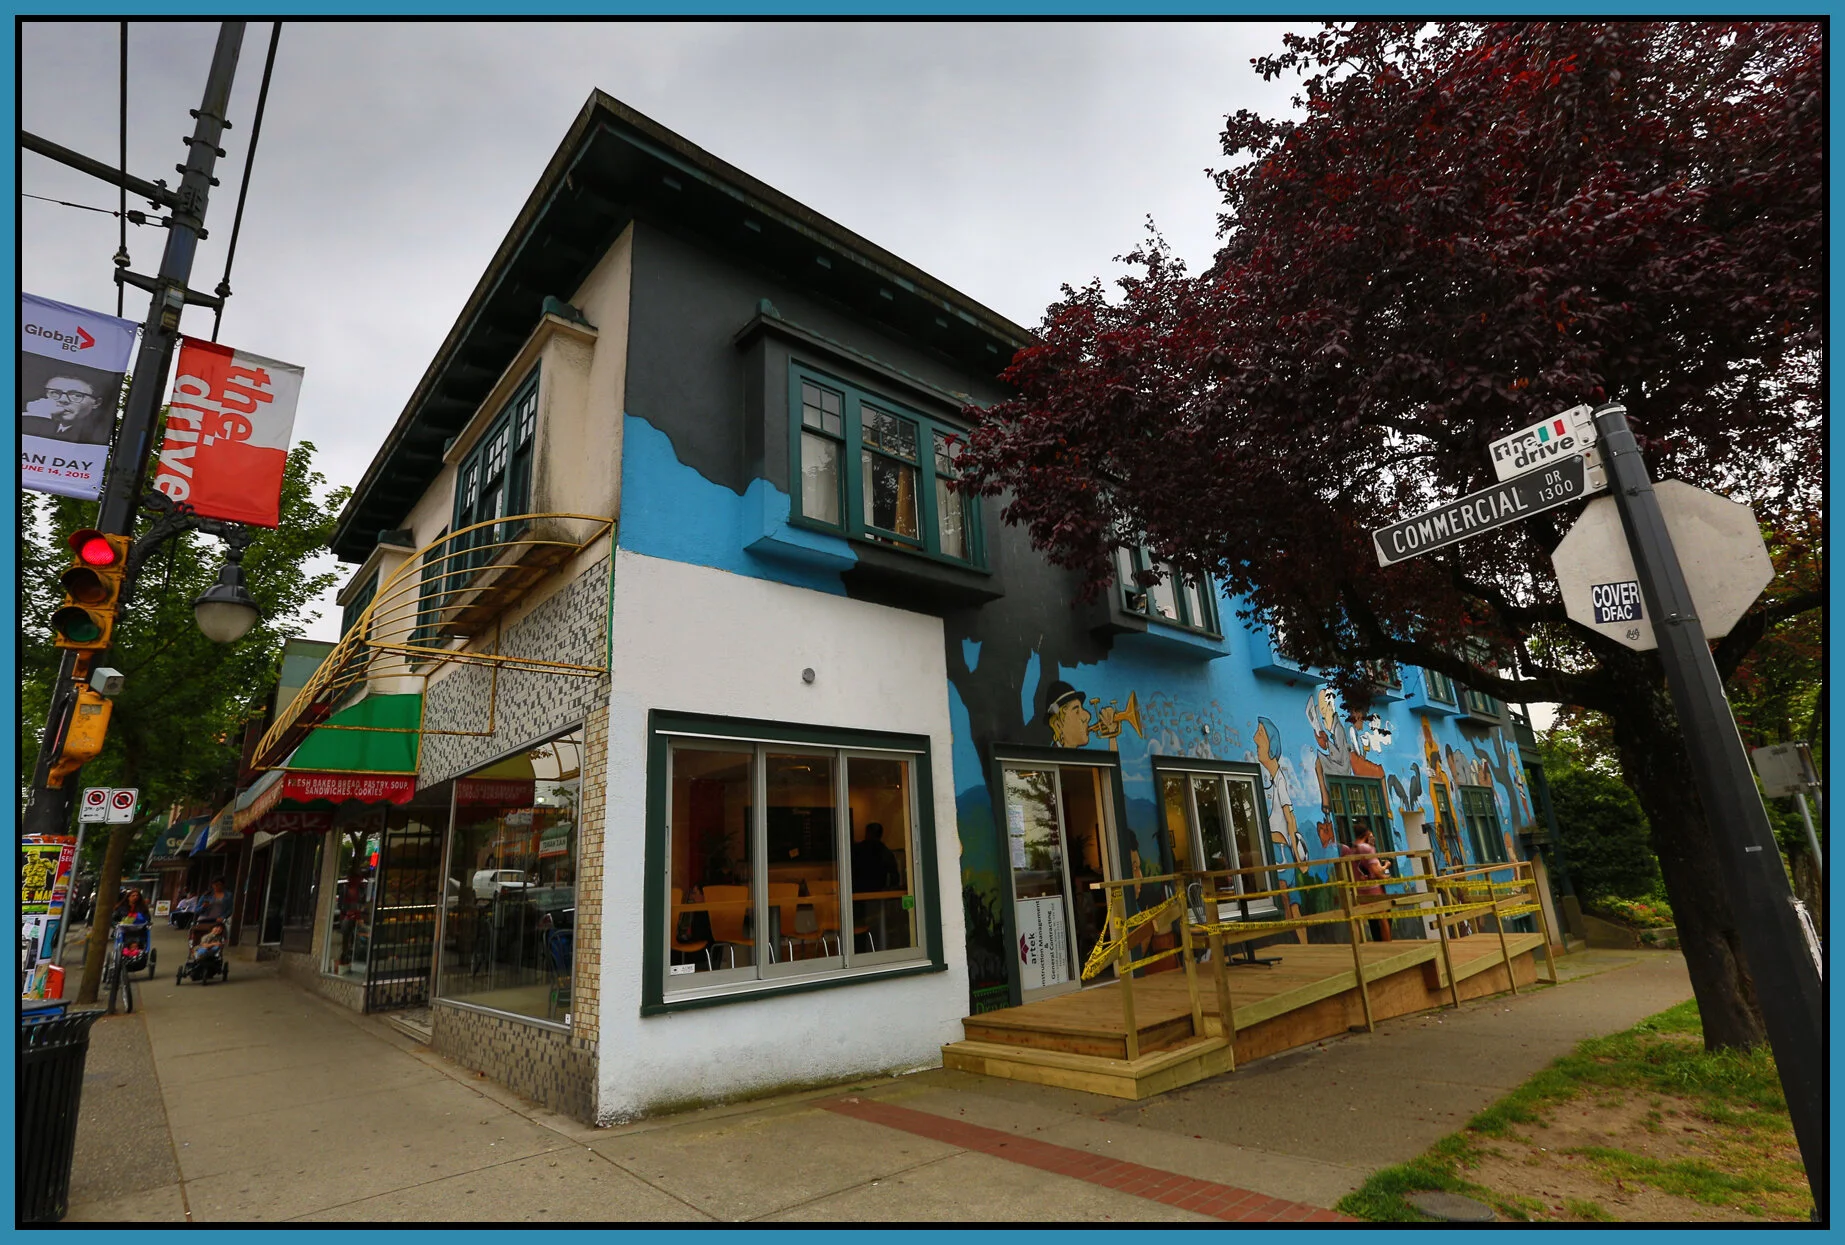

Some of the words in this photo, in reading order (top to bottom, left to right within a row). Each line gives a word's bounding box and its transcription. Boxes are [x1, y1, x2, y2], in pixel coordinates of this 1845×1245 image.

[24, 323, 80, 346] Global
[62, 343, 78, 353] BC
[216, 365, 274, 442] the
[153, 374, 223, 502] drive
[1493, 432, 1539, 461] the
[52, 457, 94, 471] DAY
[1514, 435, 1576, 469] drive
[48, 468, 62, 477] 14,
[65, 470, 90, 480] 2015
[1544, 469, 1562, 486] DR
[1538, 479, 1574, 503] 1300
[1392, 486, 1529, 554] COMMERCIAL
[1592, 582, 1640, 608] COVER
[1601, 604, 1633, 622] DFAC
[312, 779, 336, 788] BAKED
[354, 788, 383, 796] COOKIES
[1035, 900, 1044, 947] Management
[1047, 910, 1055, 951] Contracting
[1028, 933, 1037, 964] artek
